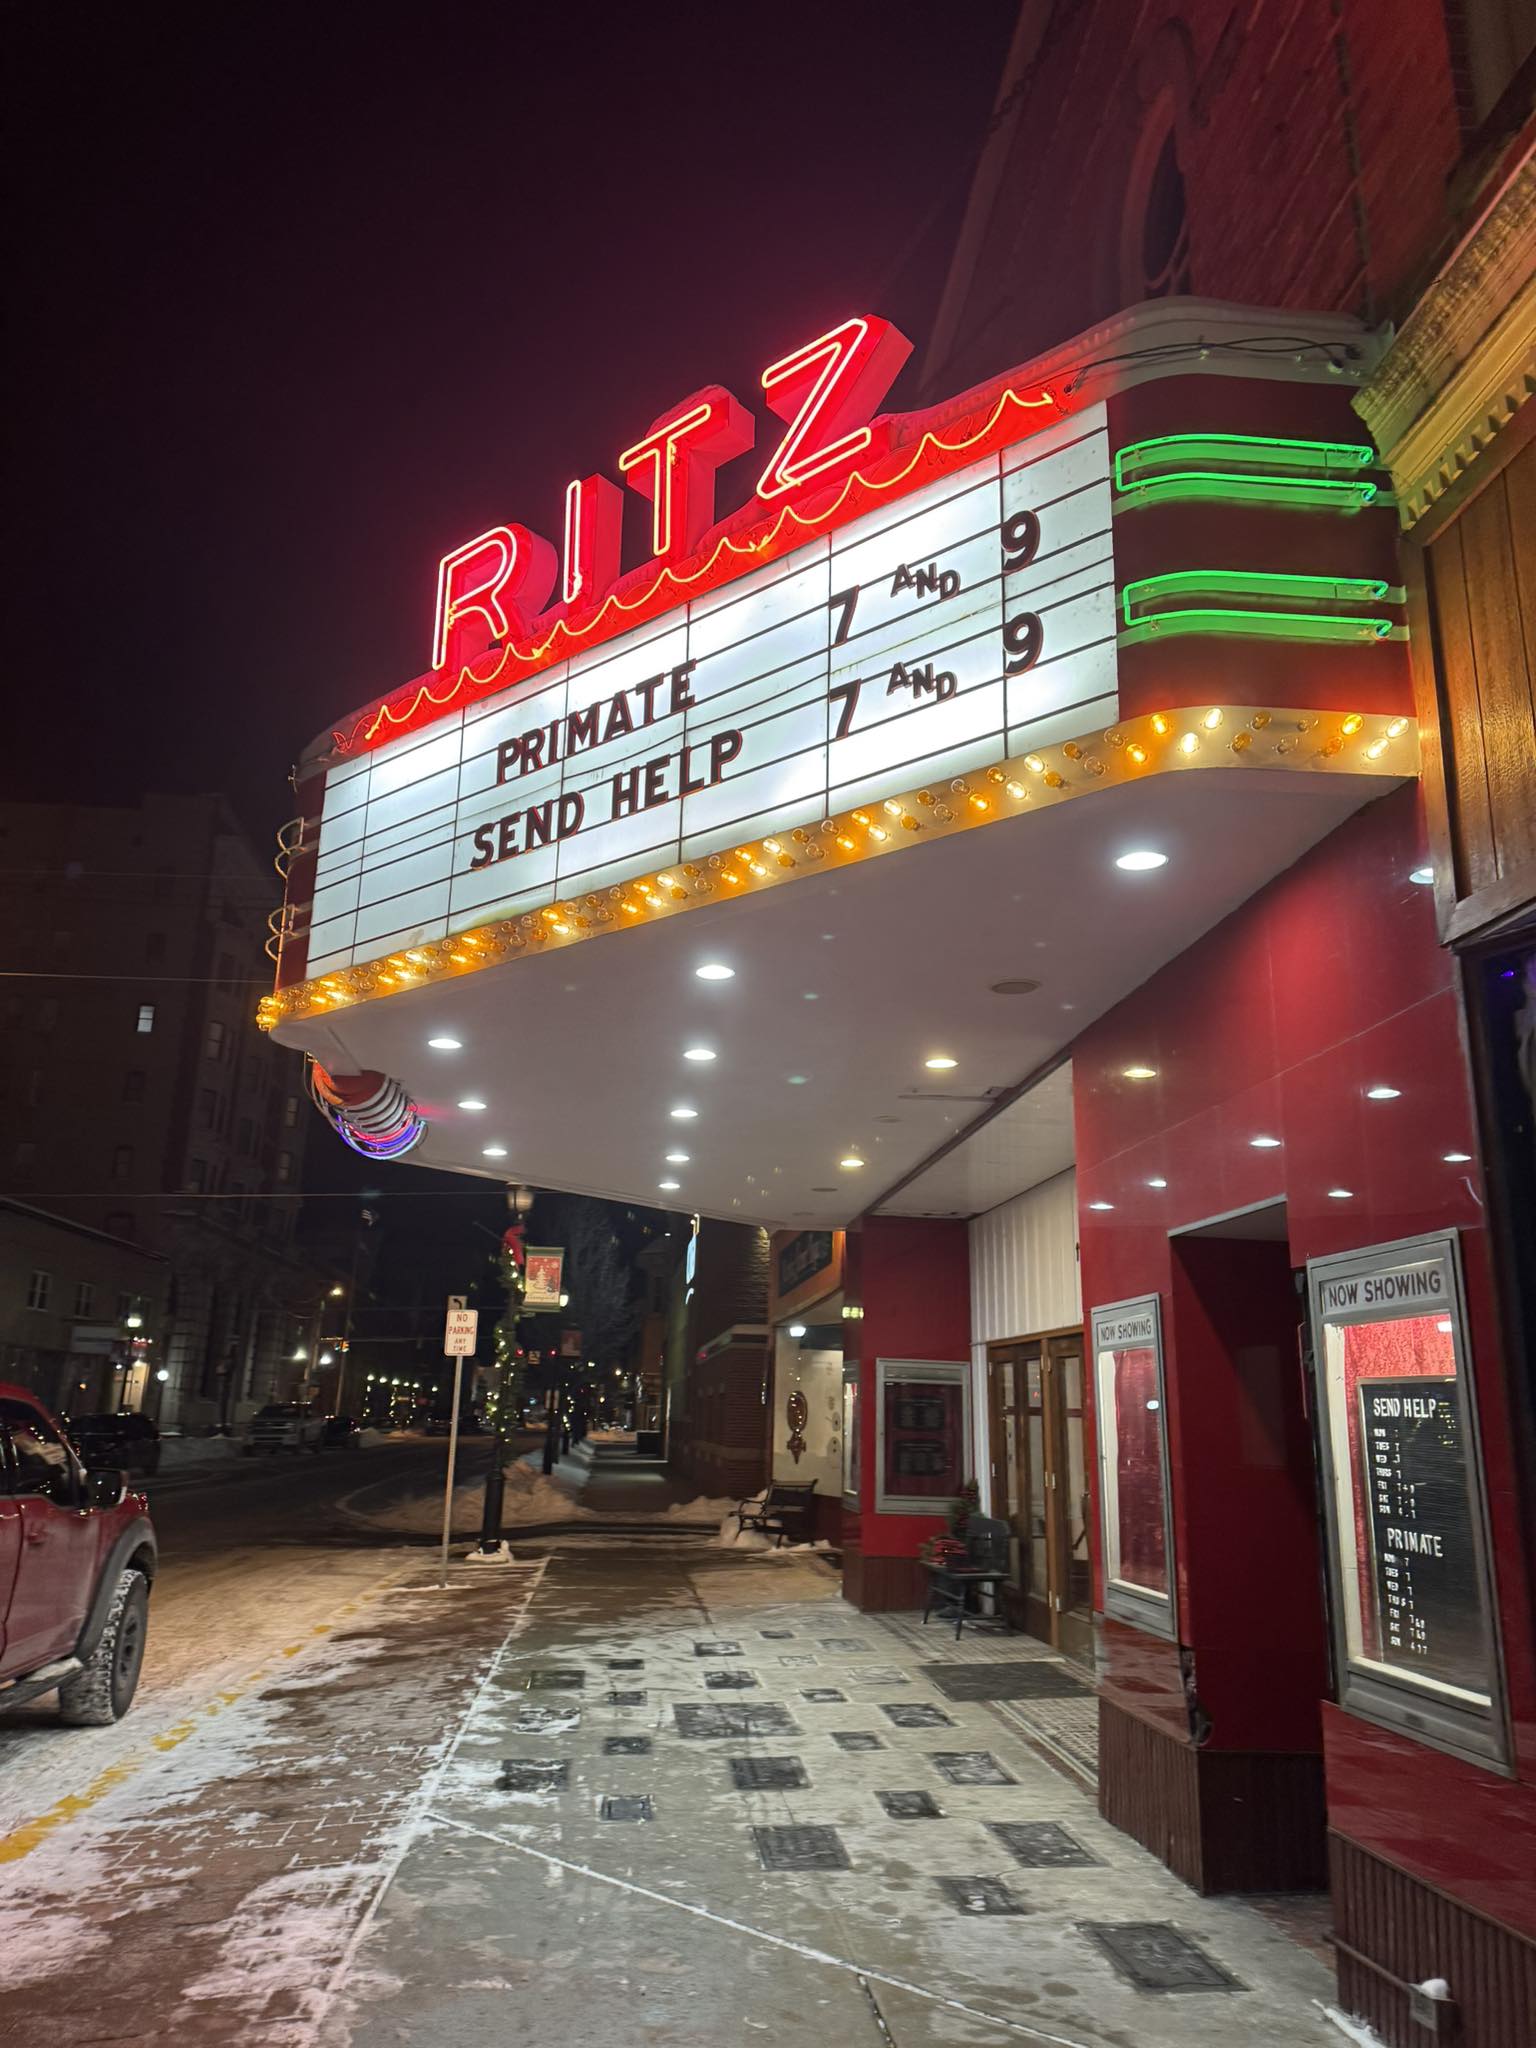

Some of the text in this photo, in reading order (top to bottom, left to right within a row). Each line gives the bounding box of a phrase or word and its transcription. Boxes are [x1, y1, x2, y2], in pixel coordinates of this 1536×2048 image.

[432, 315, 895, 671] RITZ
[496, 510, 1041, 787] PRIMATE 7 AND 9
[470, 611, 1045, 871] SEND HELP 7 AND 9
[1329, 1270, 1441, 1307] NOW SHOWING
[448, 1326, 475, 1335] PARKING
[456, 1313, 469, 1322] NO
[1101, 1319, 1152, 1341] NOW SHOWING
[1373, 1397, 1437, 1419] SEND HELP
[1386, 1527, 1444, 1558] PRIMATE
